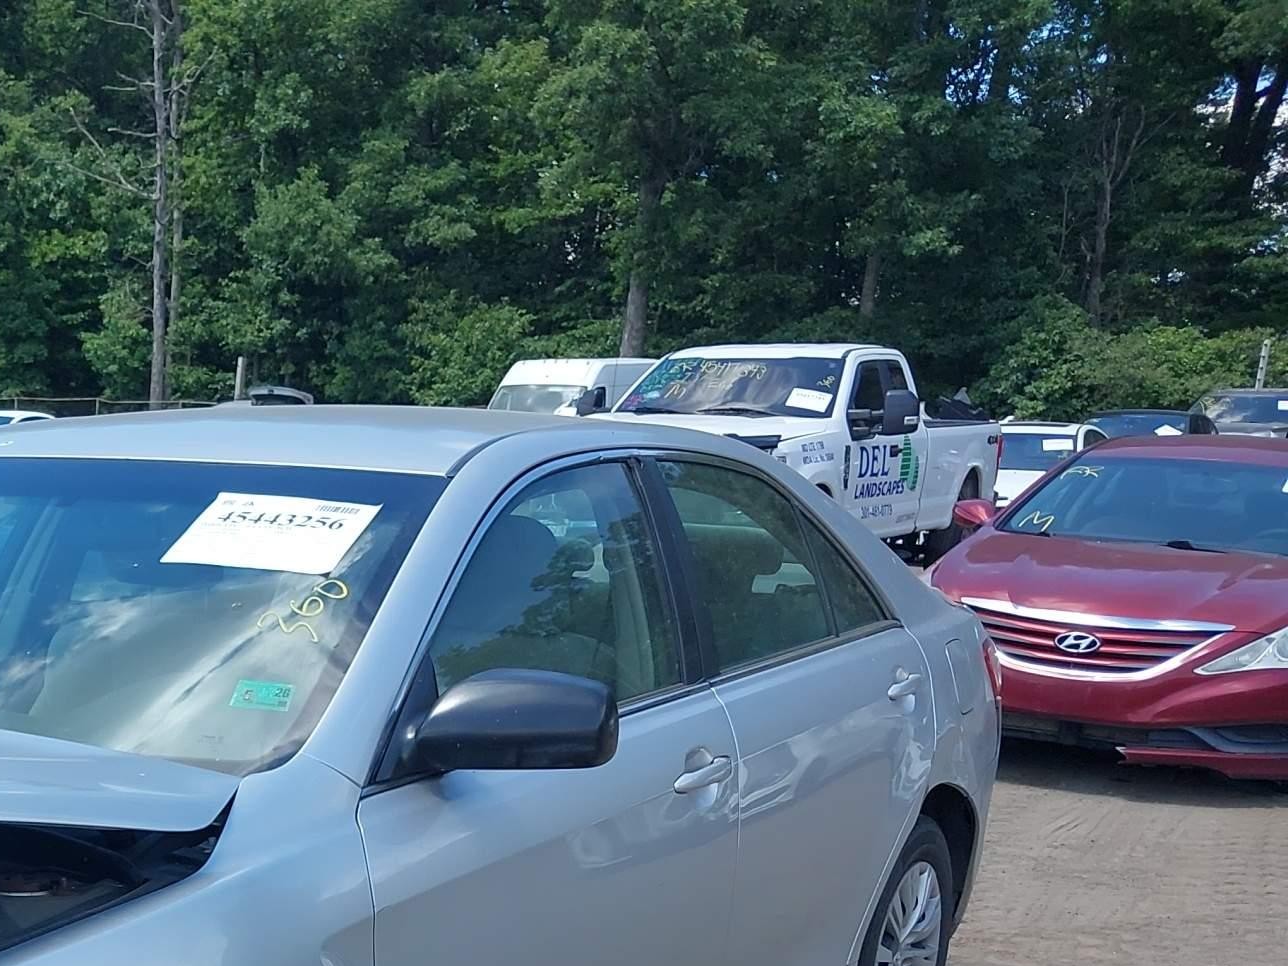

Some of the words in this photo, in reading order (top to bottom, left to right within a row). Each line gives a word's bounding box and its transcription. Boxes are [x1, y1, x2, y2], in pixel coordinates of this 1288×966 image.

[857, 445, 890, 478] DEL
[854, 480, 905, 499] LANDSCAPES
[217, 510, 347, 531] 45443256
